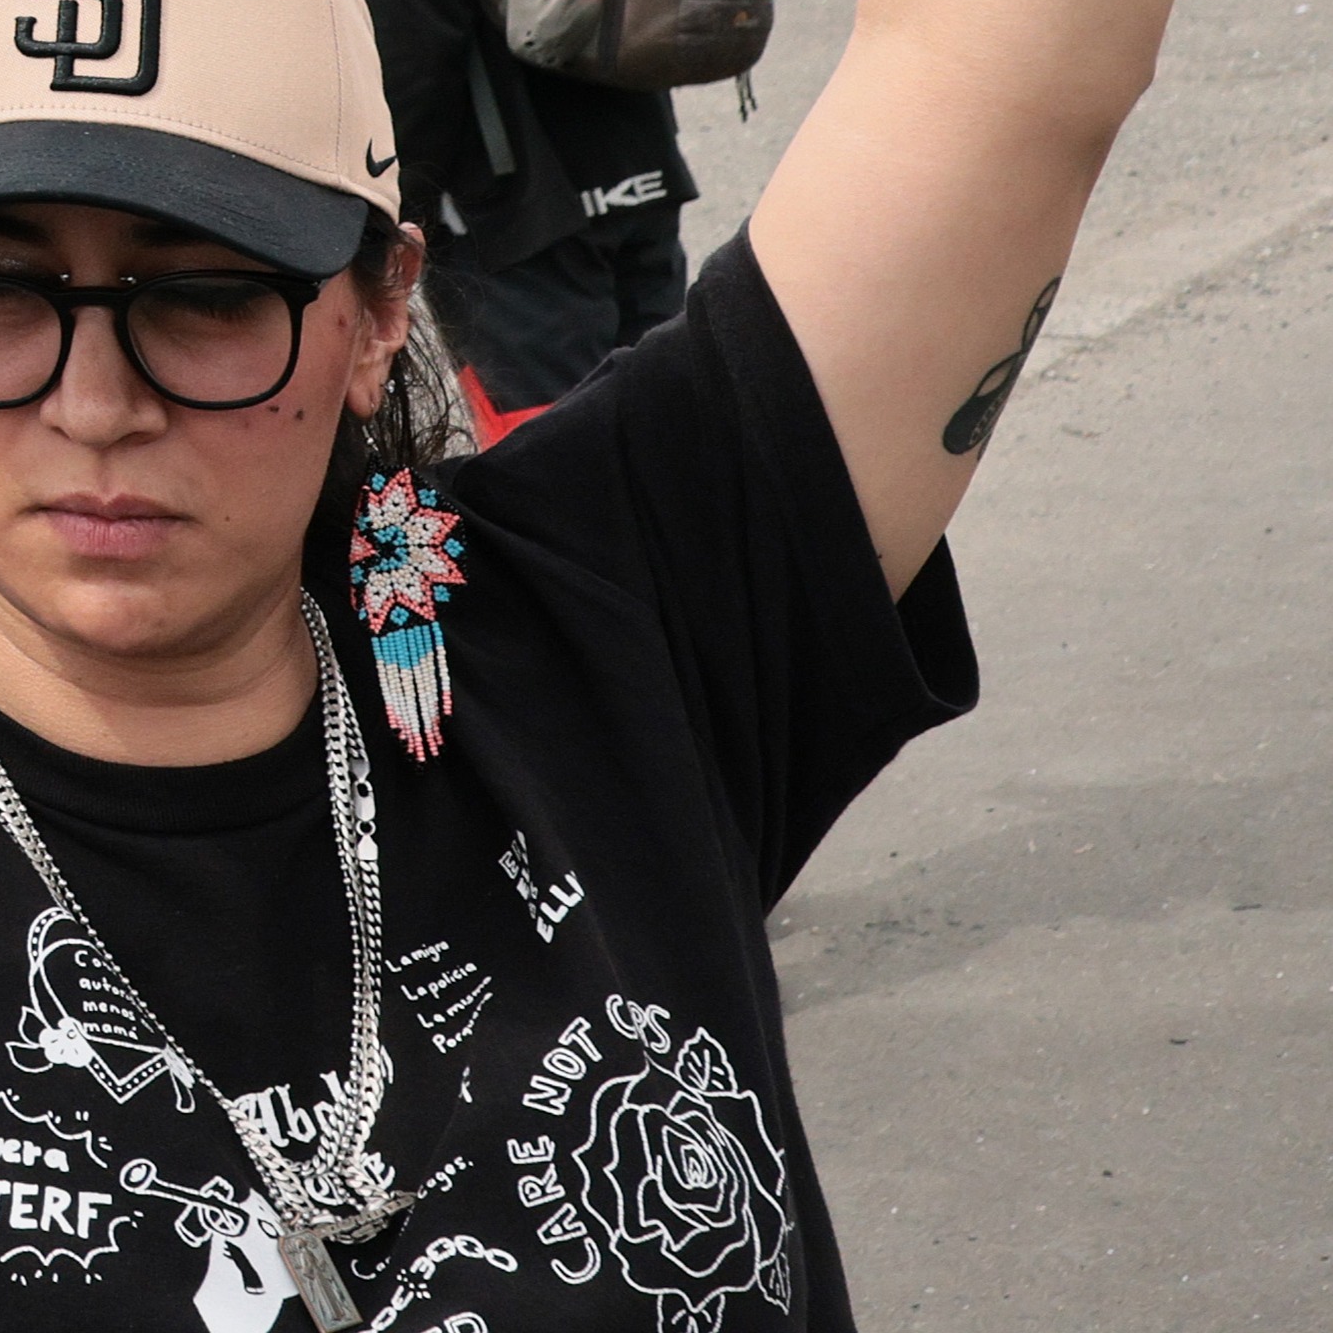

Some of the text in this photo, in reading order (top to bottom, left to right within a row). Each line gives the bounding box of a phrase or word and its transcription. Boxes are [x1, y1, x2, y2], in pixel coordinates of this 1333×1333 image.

[384, 940, 450, 973] La migra
[400, 984, 428, 1001] La
[416, 1013, 446, 1029] La
[522, 1016, 603, 1115] NOT
[506, 1135, 602, 1284] CARE
